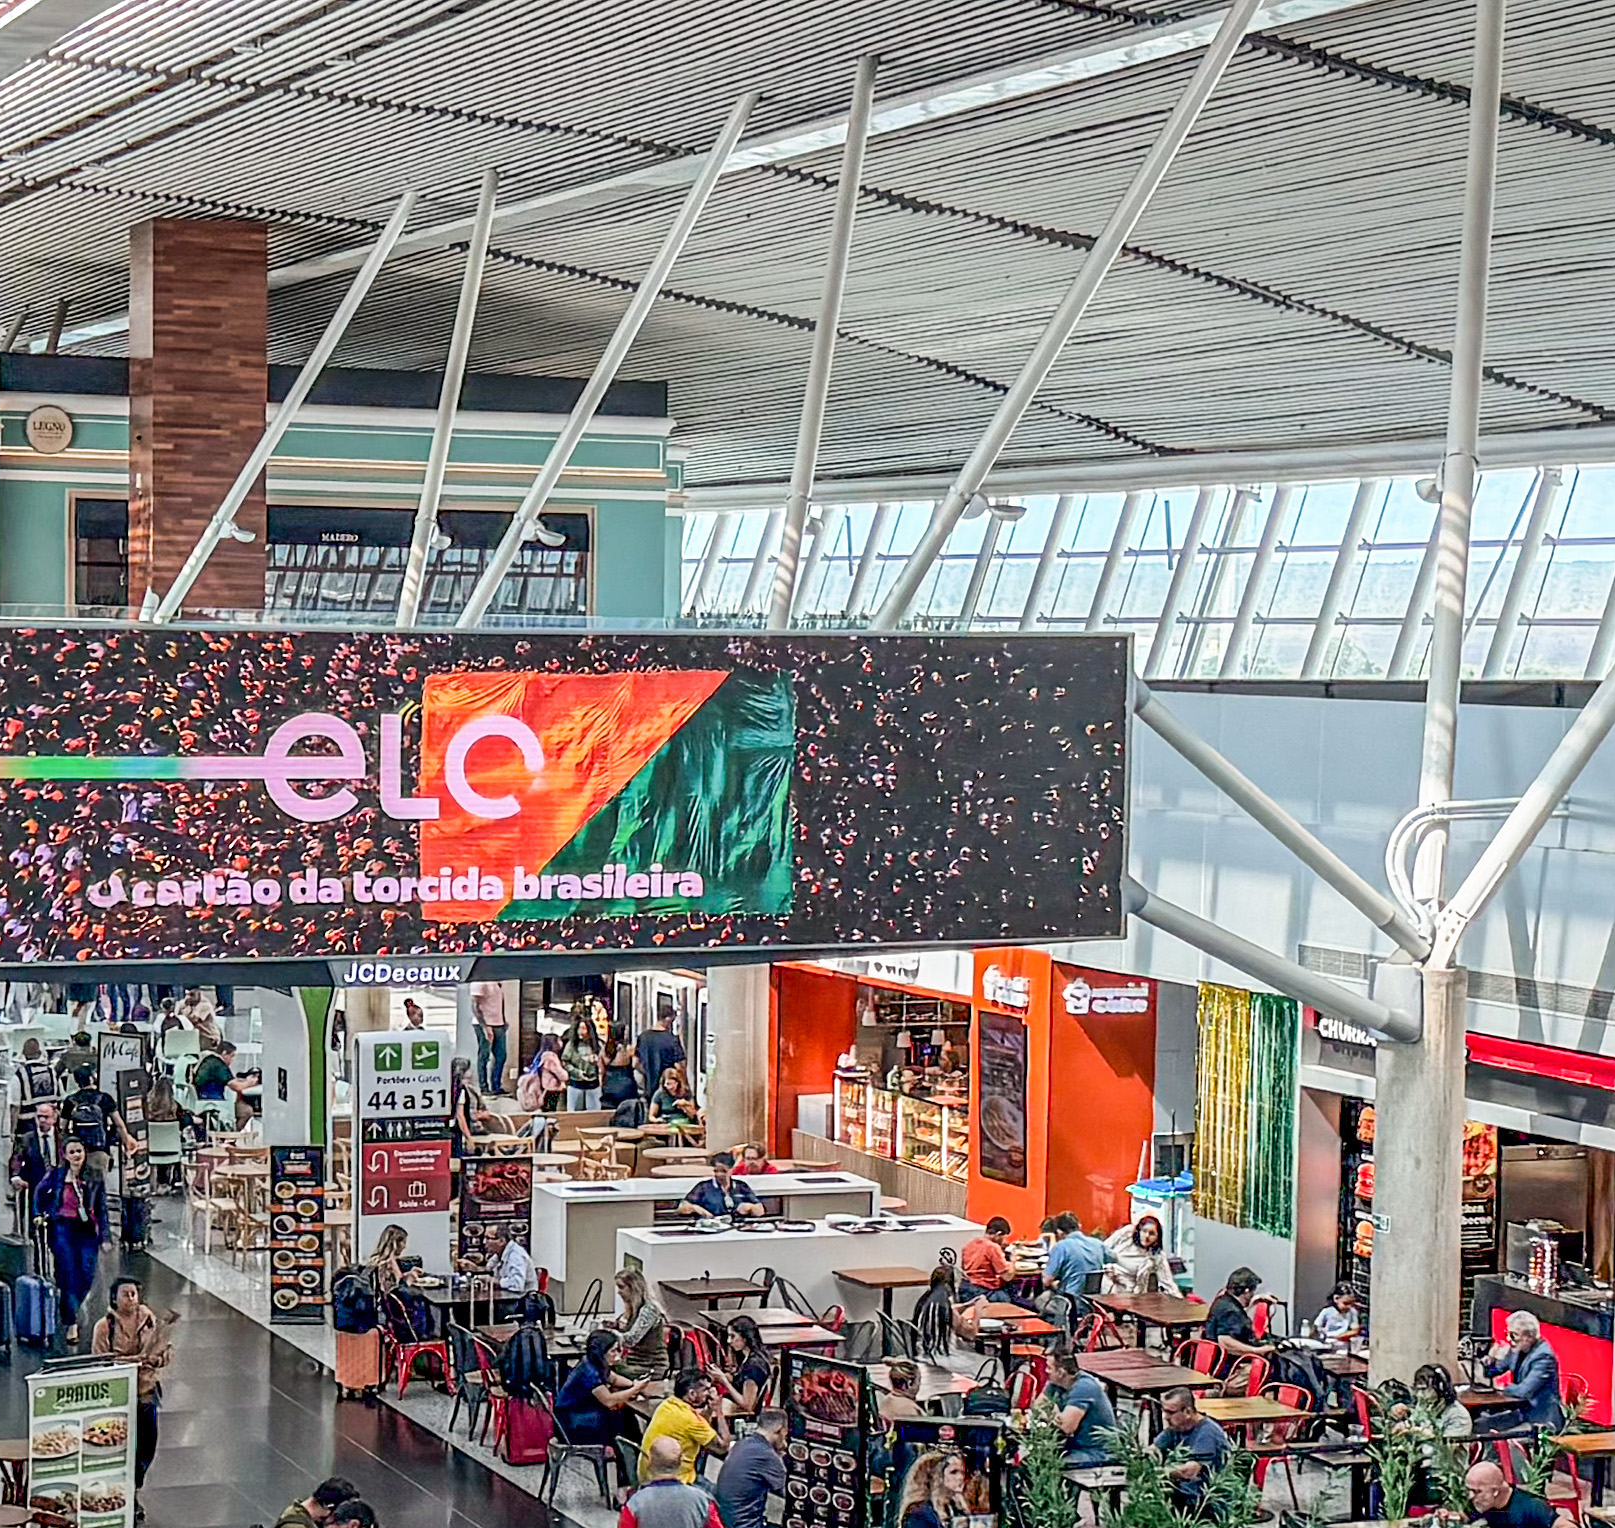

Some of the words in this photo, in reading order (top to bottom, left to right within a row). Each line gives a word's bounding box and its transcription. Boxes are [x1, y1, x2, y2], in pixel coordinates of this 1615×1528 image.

[32, 421, 66, 432] LEGNO
[132, 869, 281, 907] cartão
[289, 868, 344, 904] da
[353, 866, 503, 905] torcida
[513, 861, 704, 901] brasileira
[343, 962, 461, 984] JCDecaux
[367, 1090, 397, 1111] 44
[402, 1094, 416, 1110] a
[420, 1089, 447, 1109] 51
